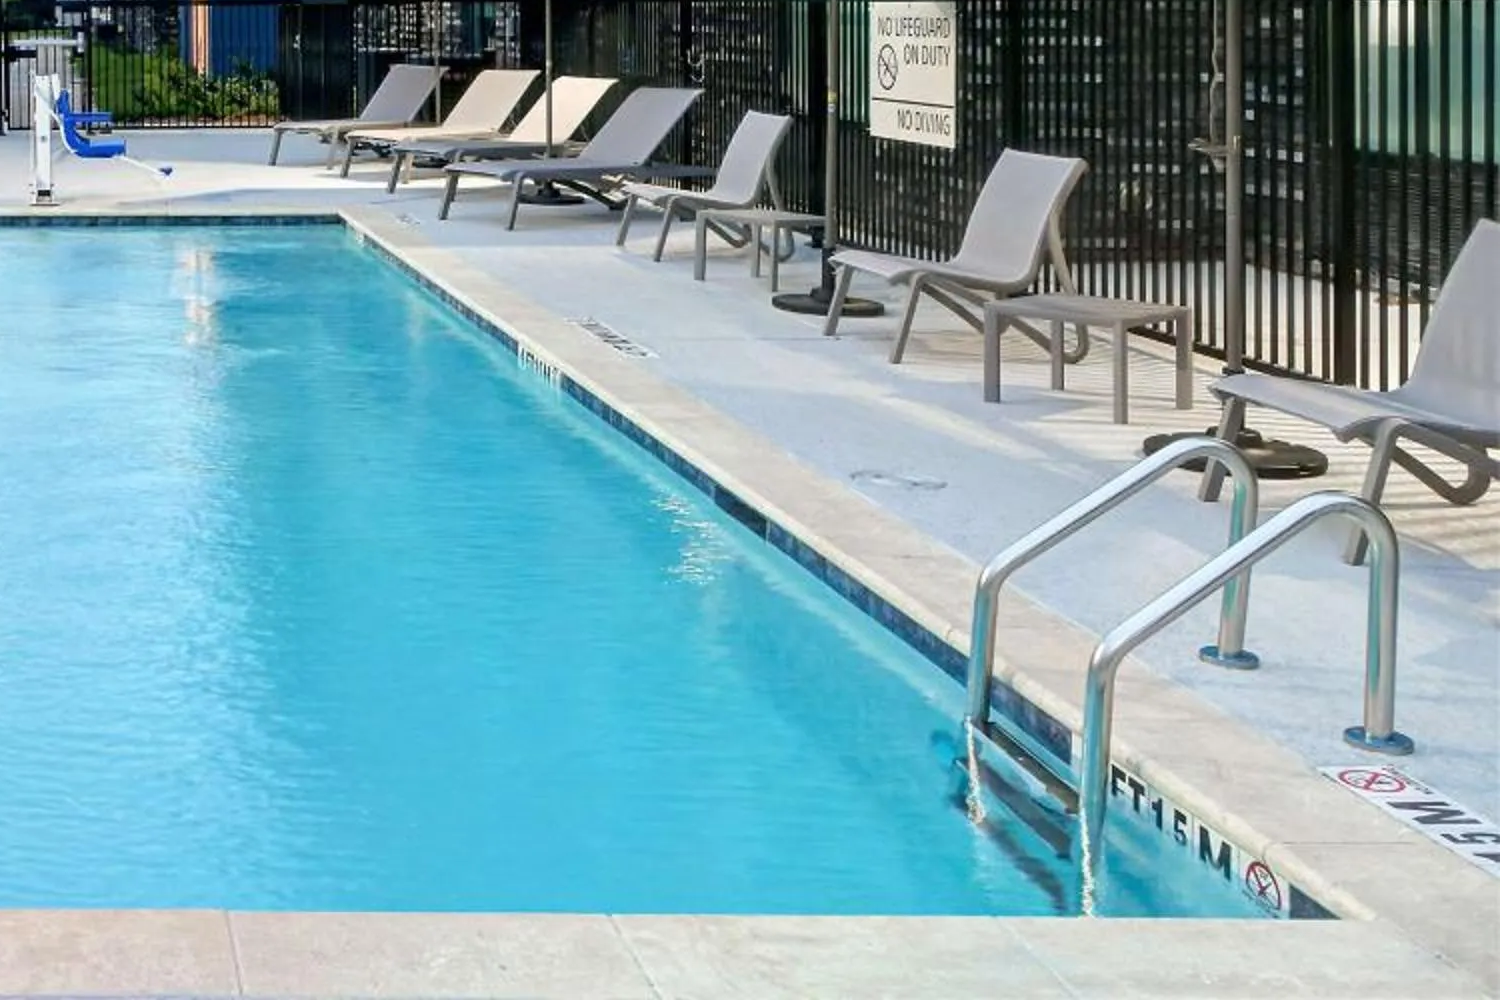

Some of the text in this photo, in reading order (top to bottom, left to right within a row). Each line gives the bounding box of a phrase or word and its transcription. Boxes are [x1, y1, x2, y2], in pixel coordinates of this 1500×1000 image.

[877, 16, 950, 39] NO LIFEGUARD
[903, 43, 950, 67] ON DUTY
[897, 109, 950, 136] NO DIVING
[1111, 763, 1145, 814] FT
[1200, 824, 1232, 882] M
